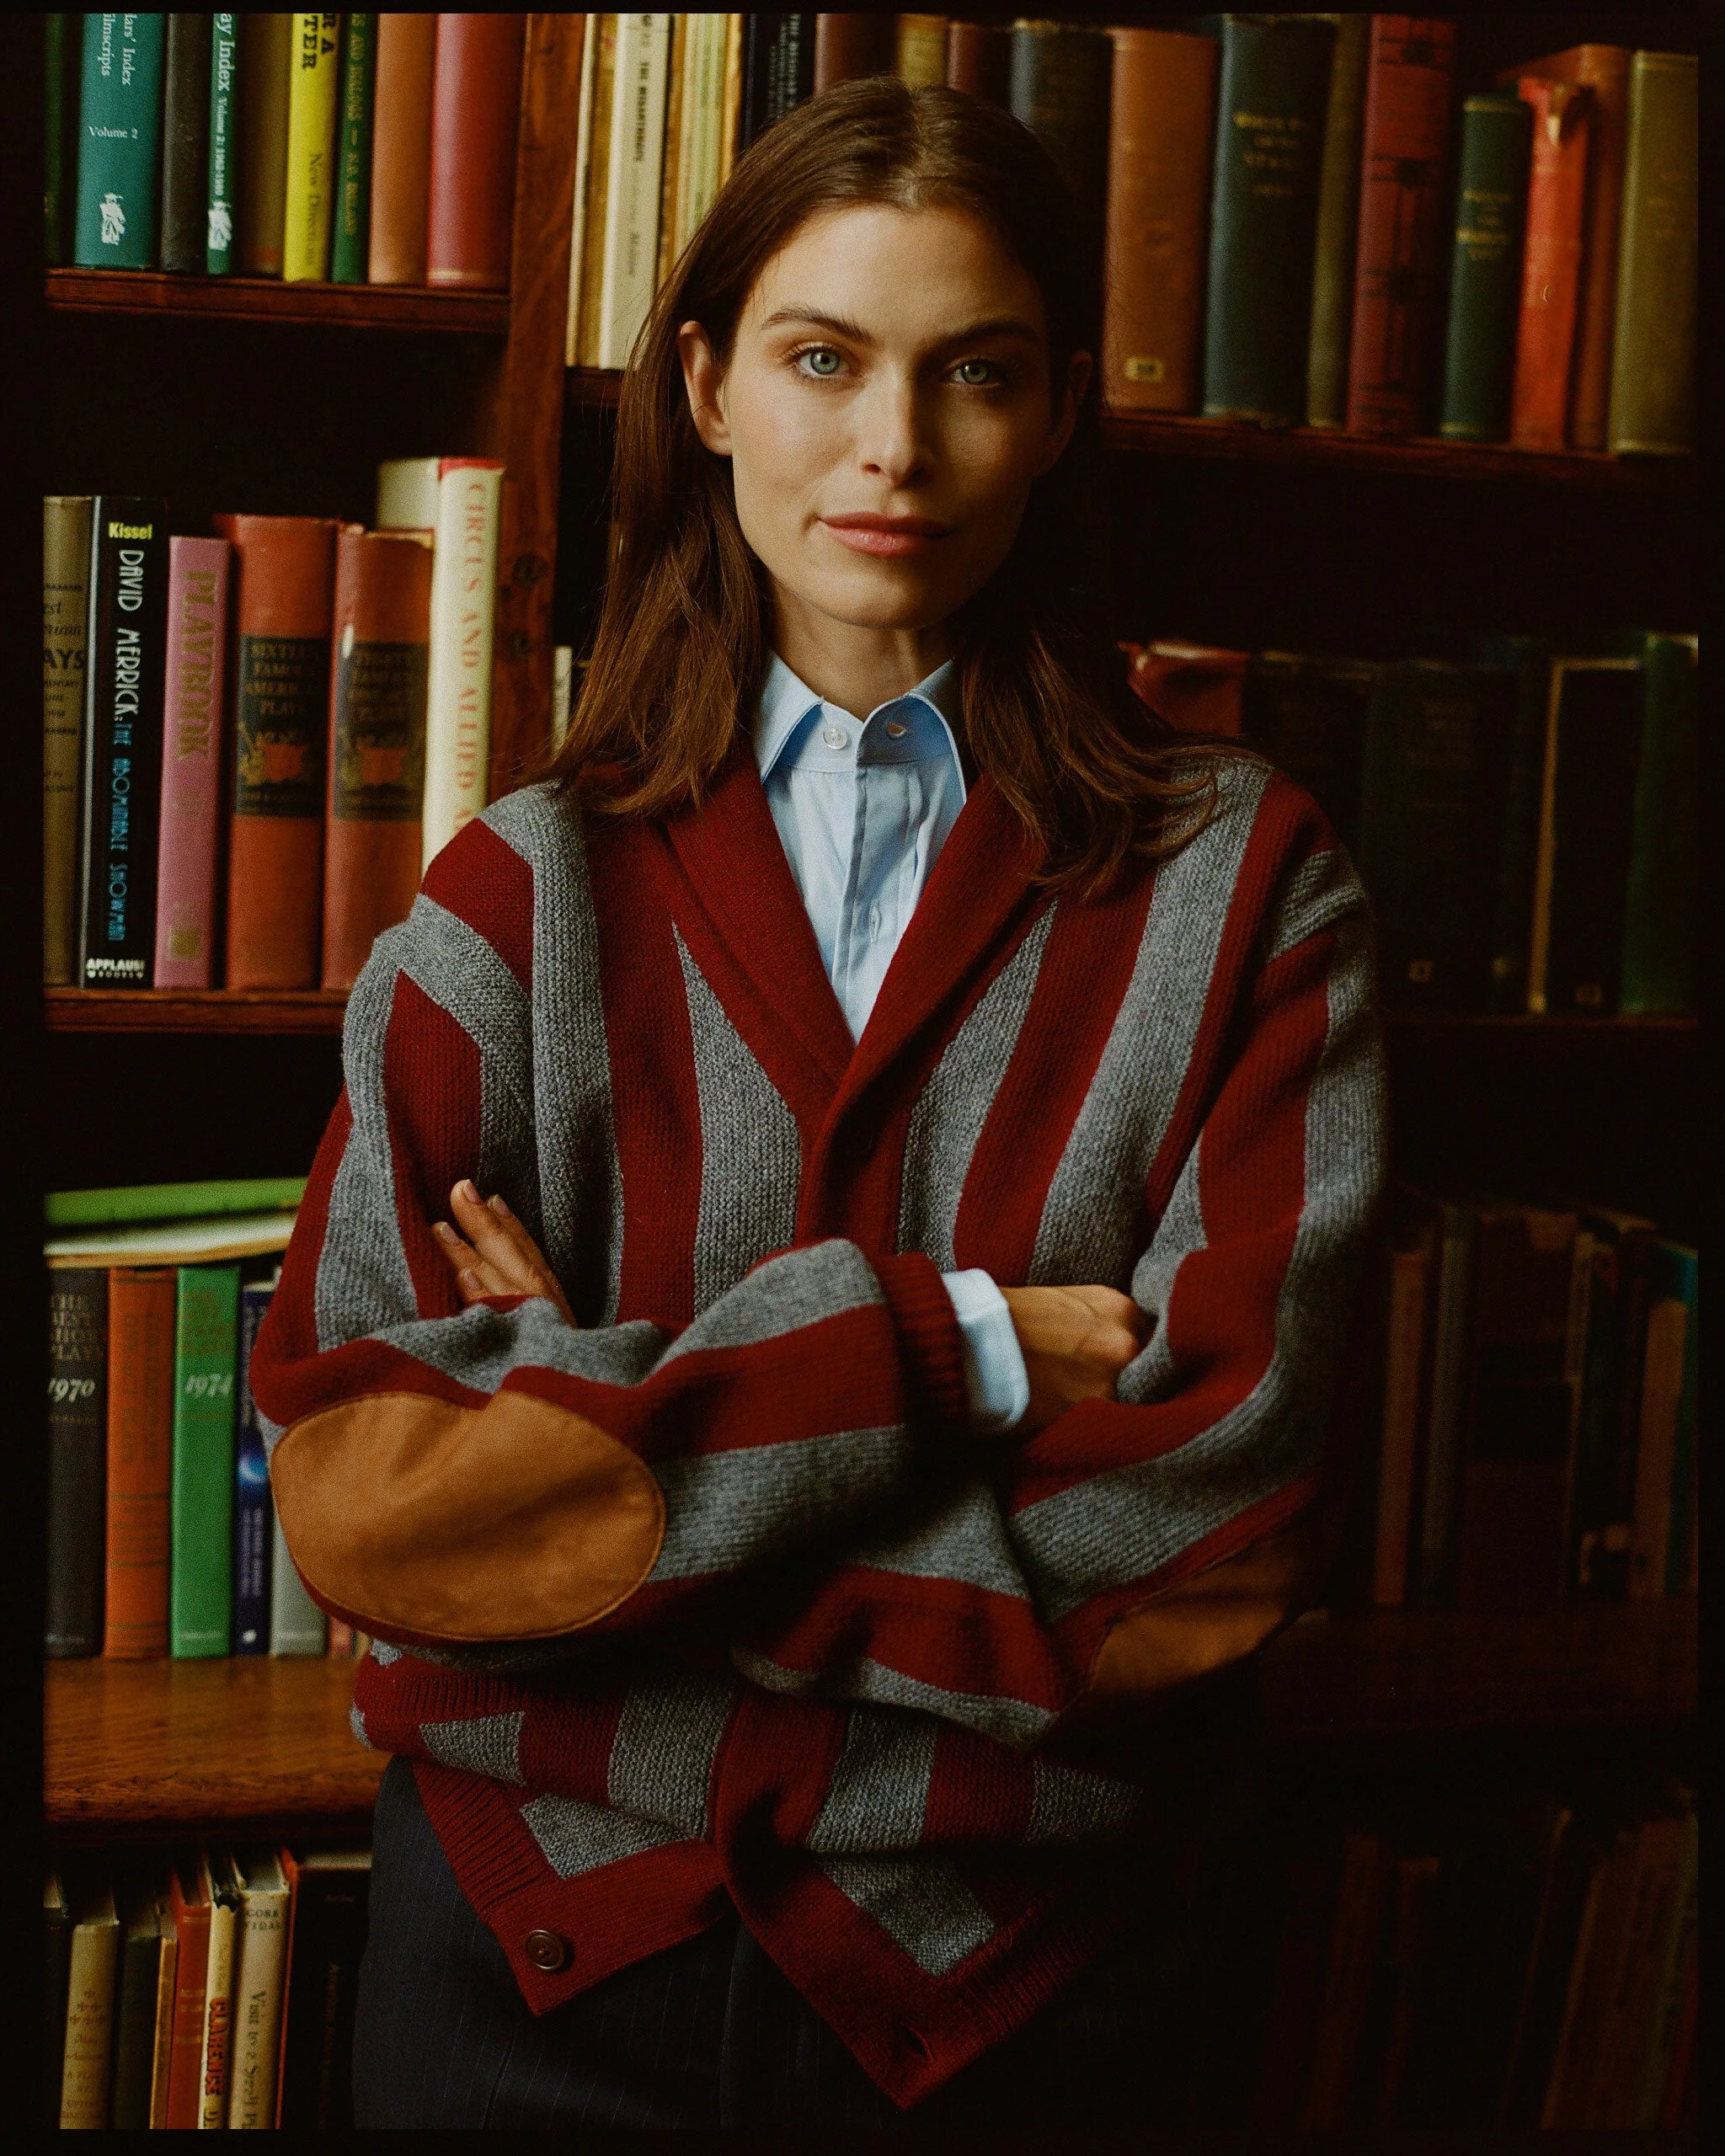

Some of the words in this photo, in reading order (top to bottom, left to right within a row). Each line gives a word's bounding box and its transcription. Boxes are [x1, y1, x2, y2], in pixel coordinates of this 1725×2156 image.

[216, 13, 233, 35] ay
[302, 15, 319, 69] TER
[321, 38, 335, 55] A
[121, 47, 136, 86] Index
[217, 40, 235, 91] Index
[88, 126, 127, 138] Volume
[131, 127, 138, 138] 2
[216, 97, 228, 133] Volume
[308, 152, 323, 186] New
[108, 520, 153, 541] Kissel
[462, 483, 487, 593] CIRCUS
[117, 548, 145, 612] DAVID
[459, 611, 482, 670] AND
[177, 569, 218, 760] PLAYBOOK
[456, 686, 480, 790] ALLIED
[47, 1377, 96, 1404] 1970
[248, 1990, 268, 2025] Visit
[205, 1996, 230, 2096] CLARENCE
[248, 2031, 259, 2046] to
